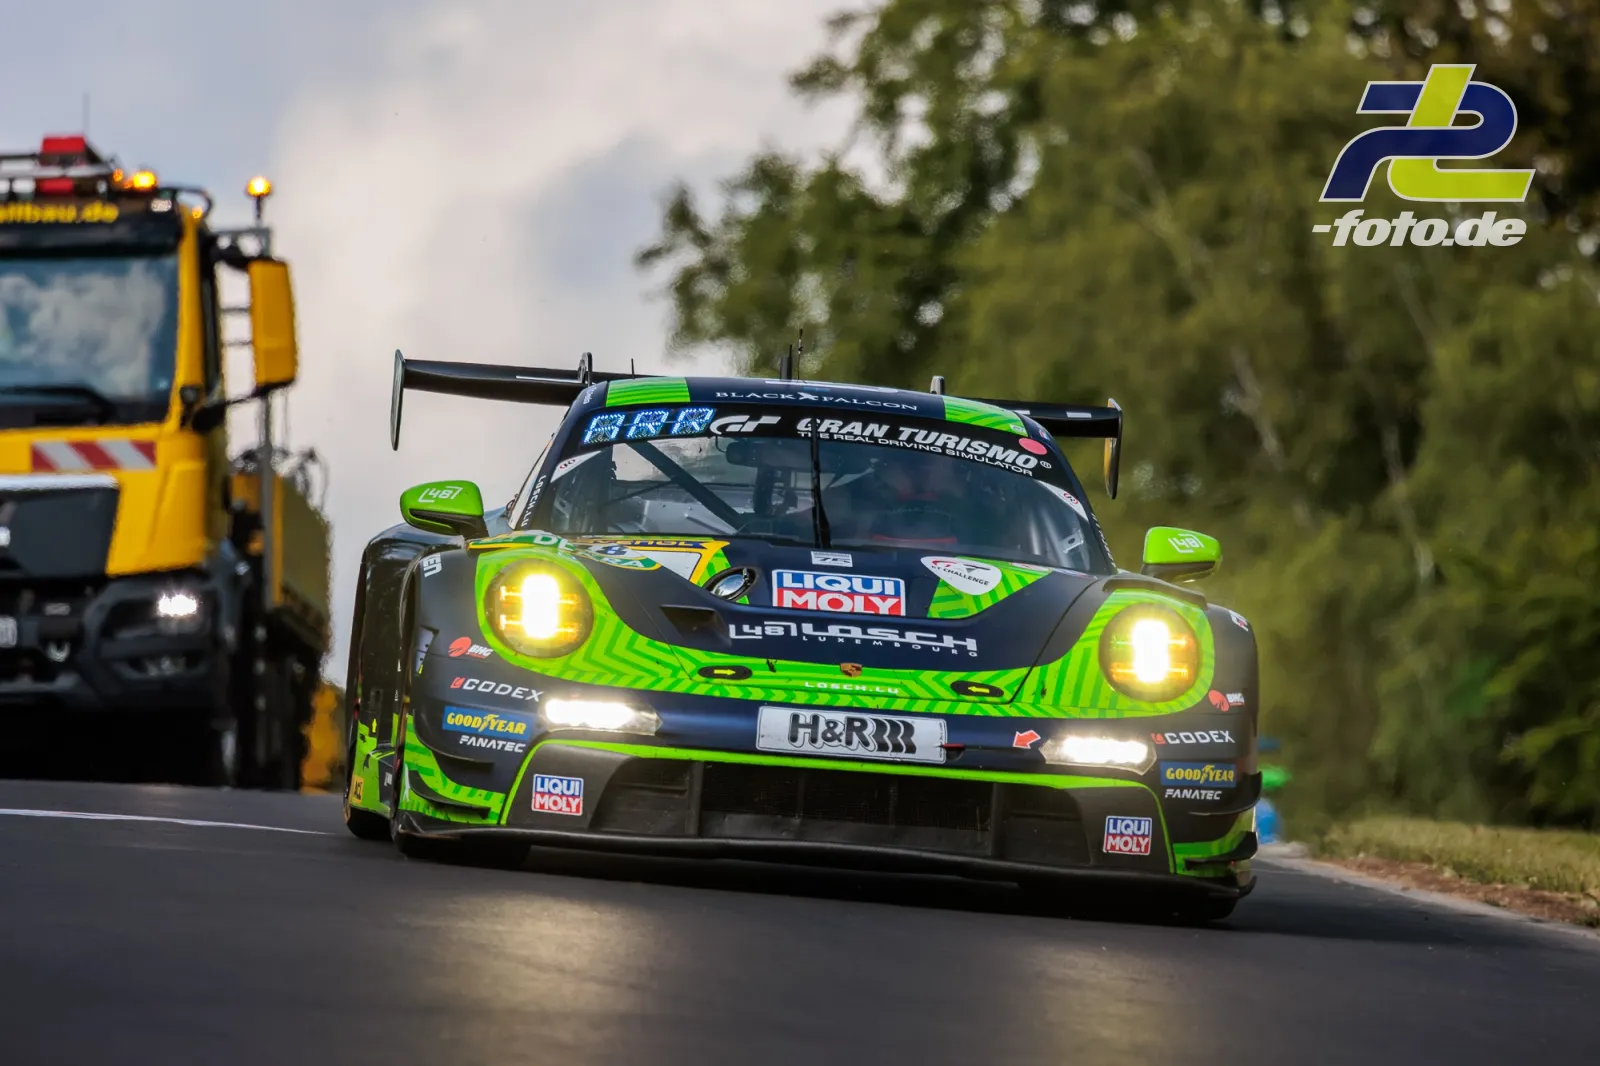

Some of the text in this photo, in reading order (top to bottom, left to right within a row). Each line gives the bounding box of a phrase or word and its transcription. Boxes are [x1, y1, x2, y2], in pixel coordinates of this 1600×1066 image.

[716, 391, 917, 411] BLACK FALCON
[797, 417, 1039, 469] GRAN TURISMO
[833, 433, 875, 444] REAL
[878, 438, 943, 454] DRIVING
[945, 449, 1034, 477] SIMULATOR
[521, 474, 547, 528] LOSCH.LU
[783, 572, 895, 596] LIQUI
[943, 568, 990, 586] CHALLENGE
[783, 590, 900, 615] MOLY
[802, 623, 978, 651] LOSCH
[802, 635, 978, 657] LUXEMBOURG
[463, 678, 544, 702] CODEX
[804, 680, 899, 694] LOSCH.LU
[446, 712, 527, 735] GOODYEAR
[788, 712, 917, 754] H&R
[459, 735, 526, 753] FANATEC
[1165, 730, 1235, 745] CODEX
[1166, 764, 1234, 784] GOODYEAR
[535, 777, 581, 796] LIQUI
[1165, 788, 1222, 801] FANATEC
[534, 795, 581, 813] MOLY
[1108, 818, 1150, 834] LIQUI
[1106, 835, 1150, 852] MOLY
